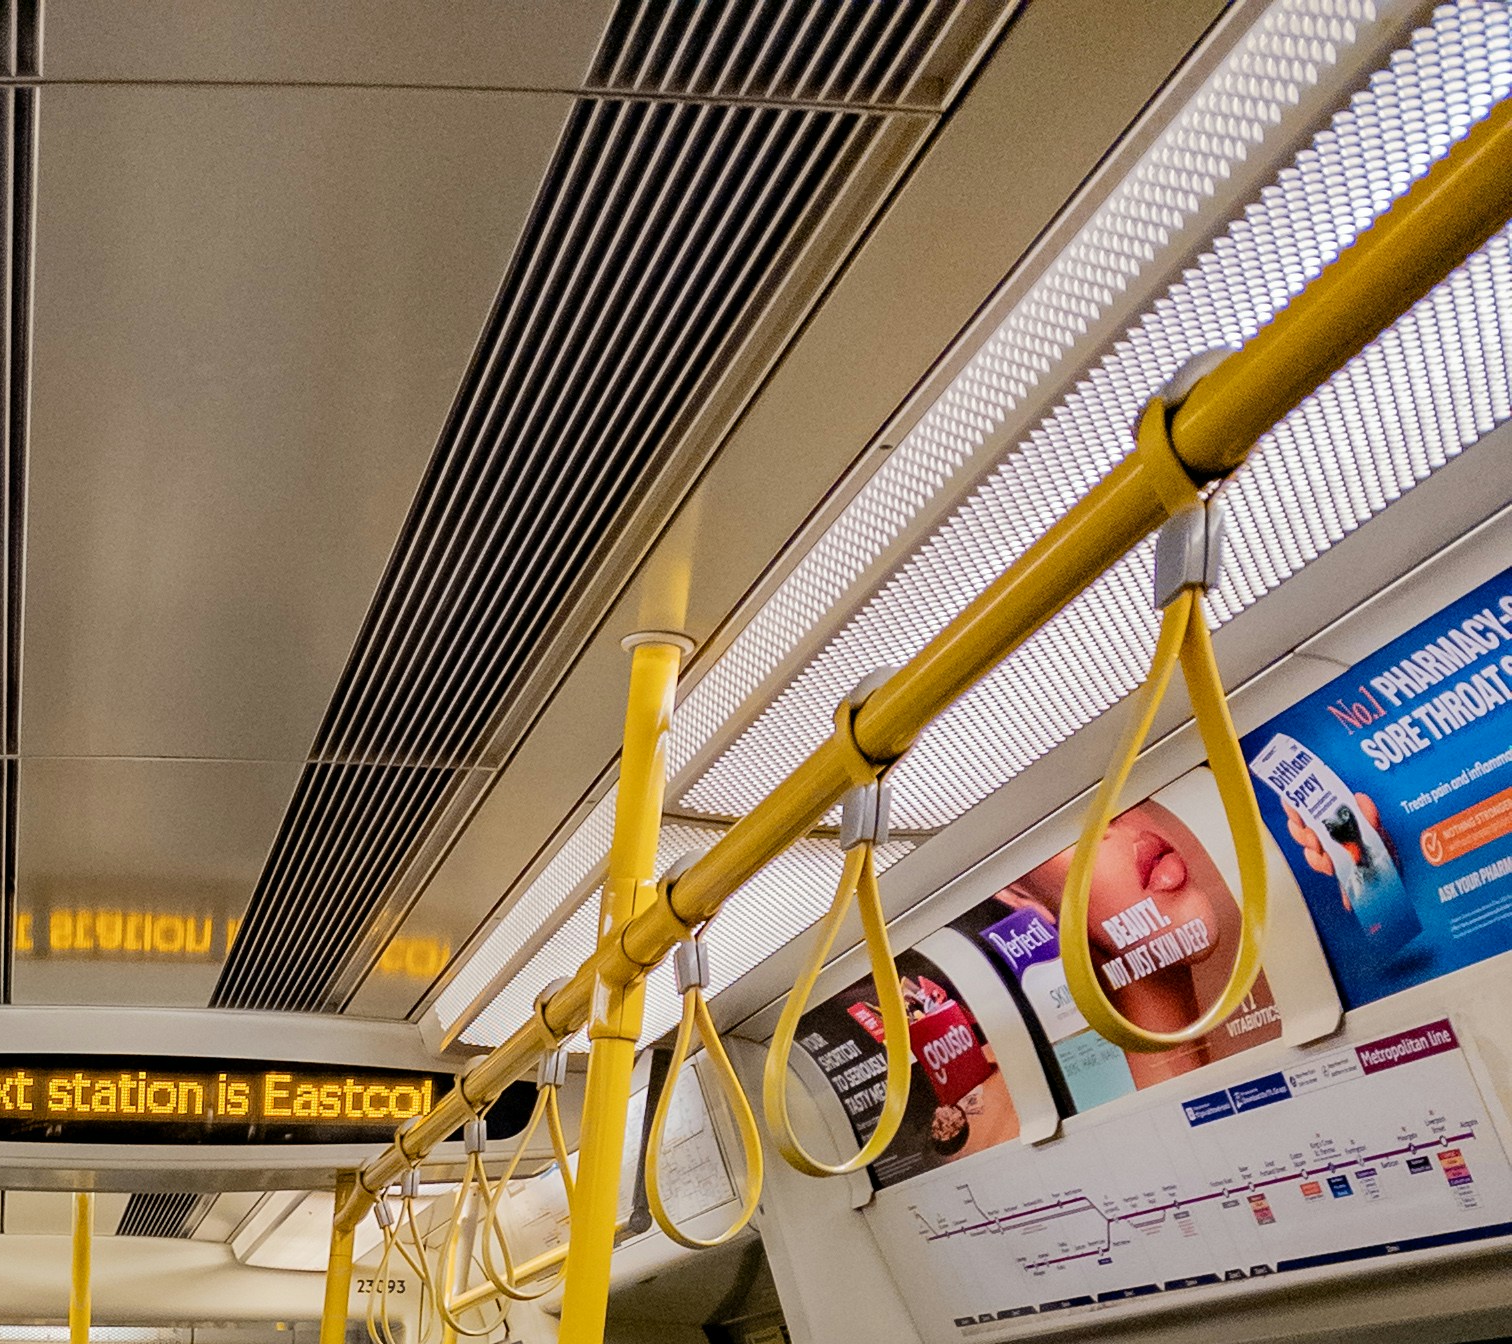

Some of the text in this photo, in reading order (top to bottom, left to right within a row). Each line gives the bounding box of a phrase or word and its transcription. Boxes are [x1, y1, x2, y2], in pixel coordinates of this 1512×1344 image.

[1327, 685, 1387, 735] No.1
[1360, 664, 1512, 771] SORE THROAT
[1268, 751, 1313, 791] Difflam
[1286, 773, 1324, 808] Spray
[1400, 792, 1434, 814] Treats
[1431, 782, 1452, 804] pain
[1450, 769, 1470, 790] and
[1438, 882, 1459, 904] ASK
[1455, 871, 1481, 895] YOUR
[988, 916, 1055, 969] Perfectil
[1101, 896, 1172, 950] BEAUTY.
[1101, 917, 1211, 992] NOT JUST SKIN DEEP
[818, 1039, 862, 1073] SHORTCUT
[923, 1024, 974, 1085] gousto
[1360, 1028, 1452, 1068] Metropolitan line
[48, 1071, 204, 1115] station
[217, 1073, 250, 1116] is
[831, 1052, 888, 1093] TO SERIOUSLY
[844, 1089, 873, 1116] TASTY
